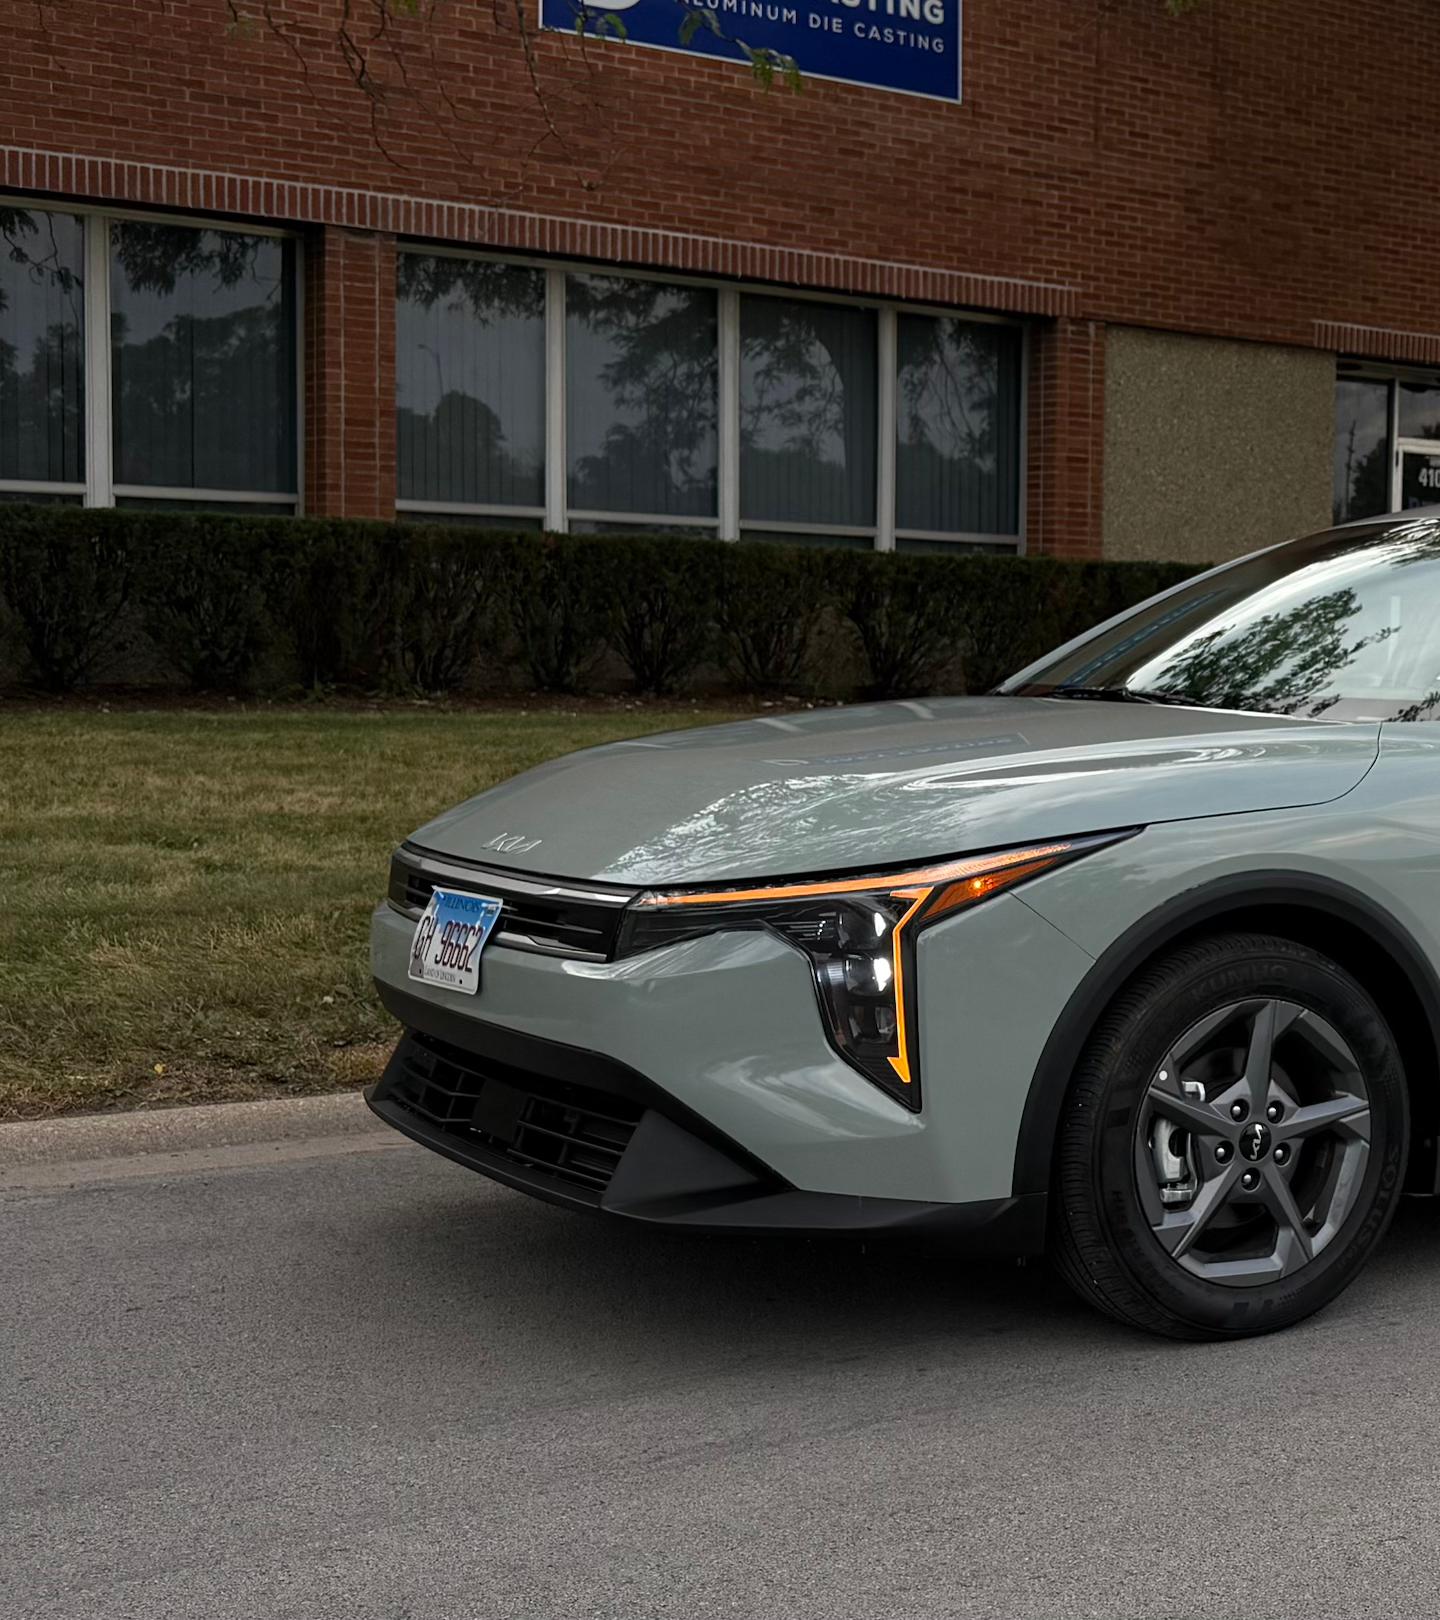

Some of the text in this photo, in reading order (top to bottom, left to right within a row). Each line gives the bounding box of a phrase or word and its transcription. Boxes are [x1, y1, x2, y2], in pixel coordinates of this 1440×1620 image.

[674, 0, 945, 53] UMINUM DIE CASTING
[482, 832, 543, 854] KIA
[414, 915, 483, 973] GH 96662
